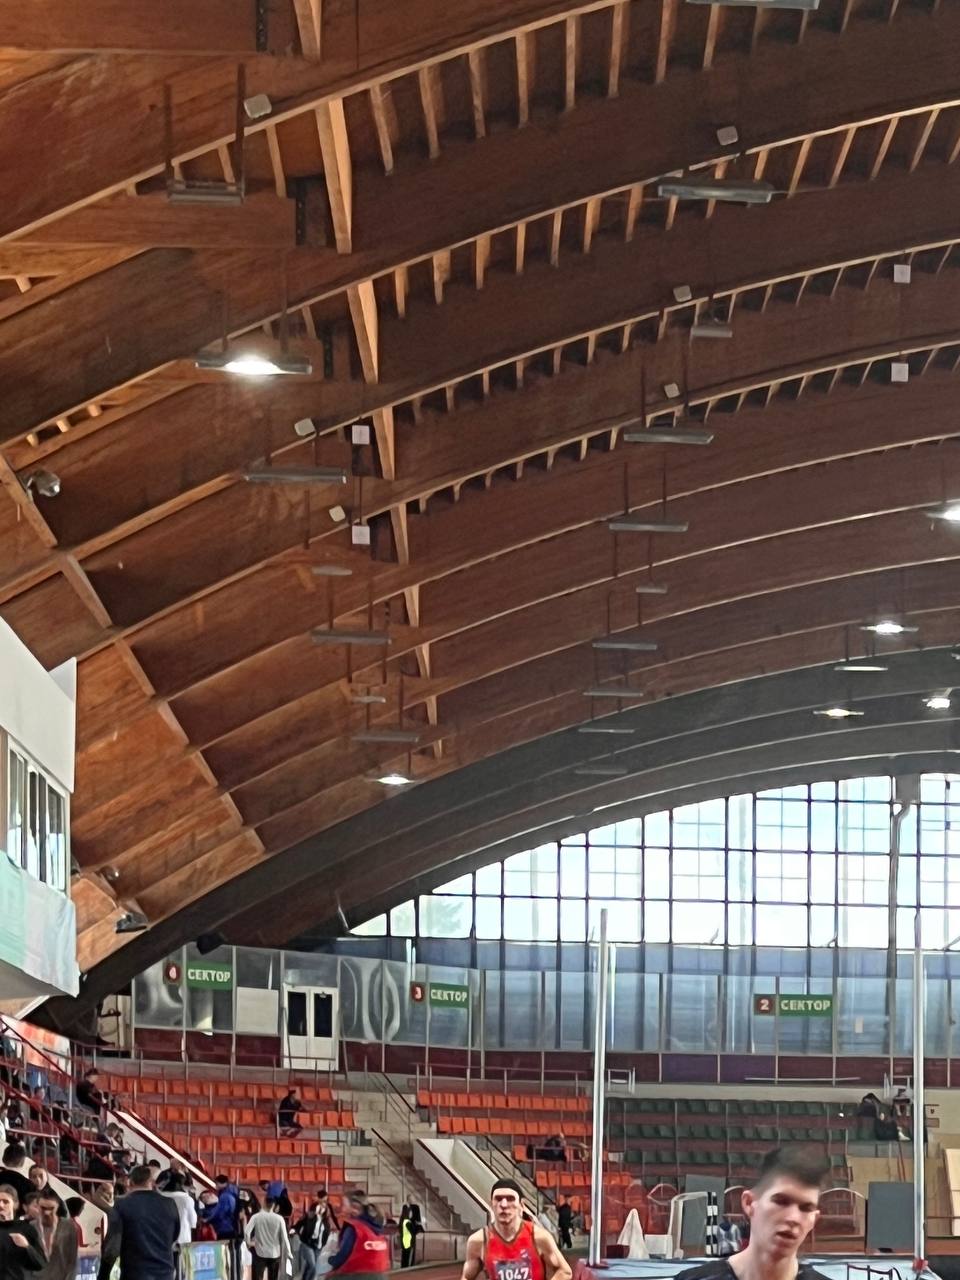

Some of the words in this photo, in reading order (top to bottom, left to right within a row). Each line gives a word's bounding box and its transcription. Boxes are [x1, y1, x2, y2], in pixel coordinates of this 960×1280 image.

[187, 968, 231, 982] СЕКТОР
[759, 998, 770, 1011] 2
[780, 999, 831, 1011] СЕКТОР
[497, 1267, 529, 1280] 1047
